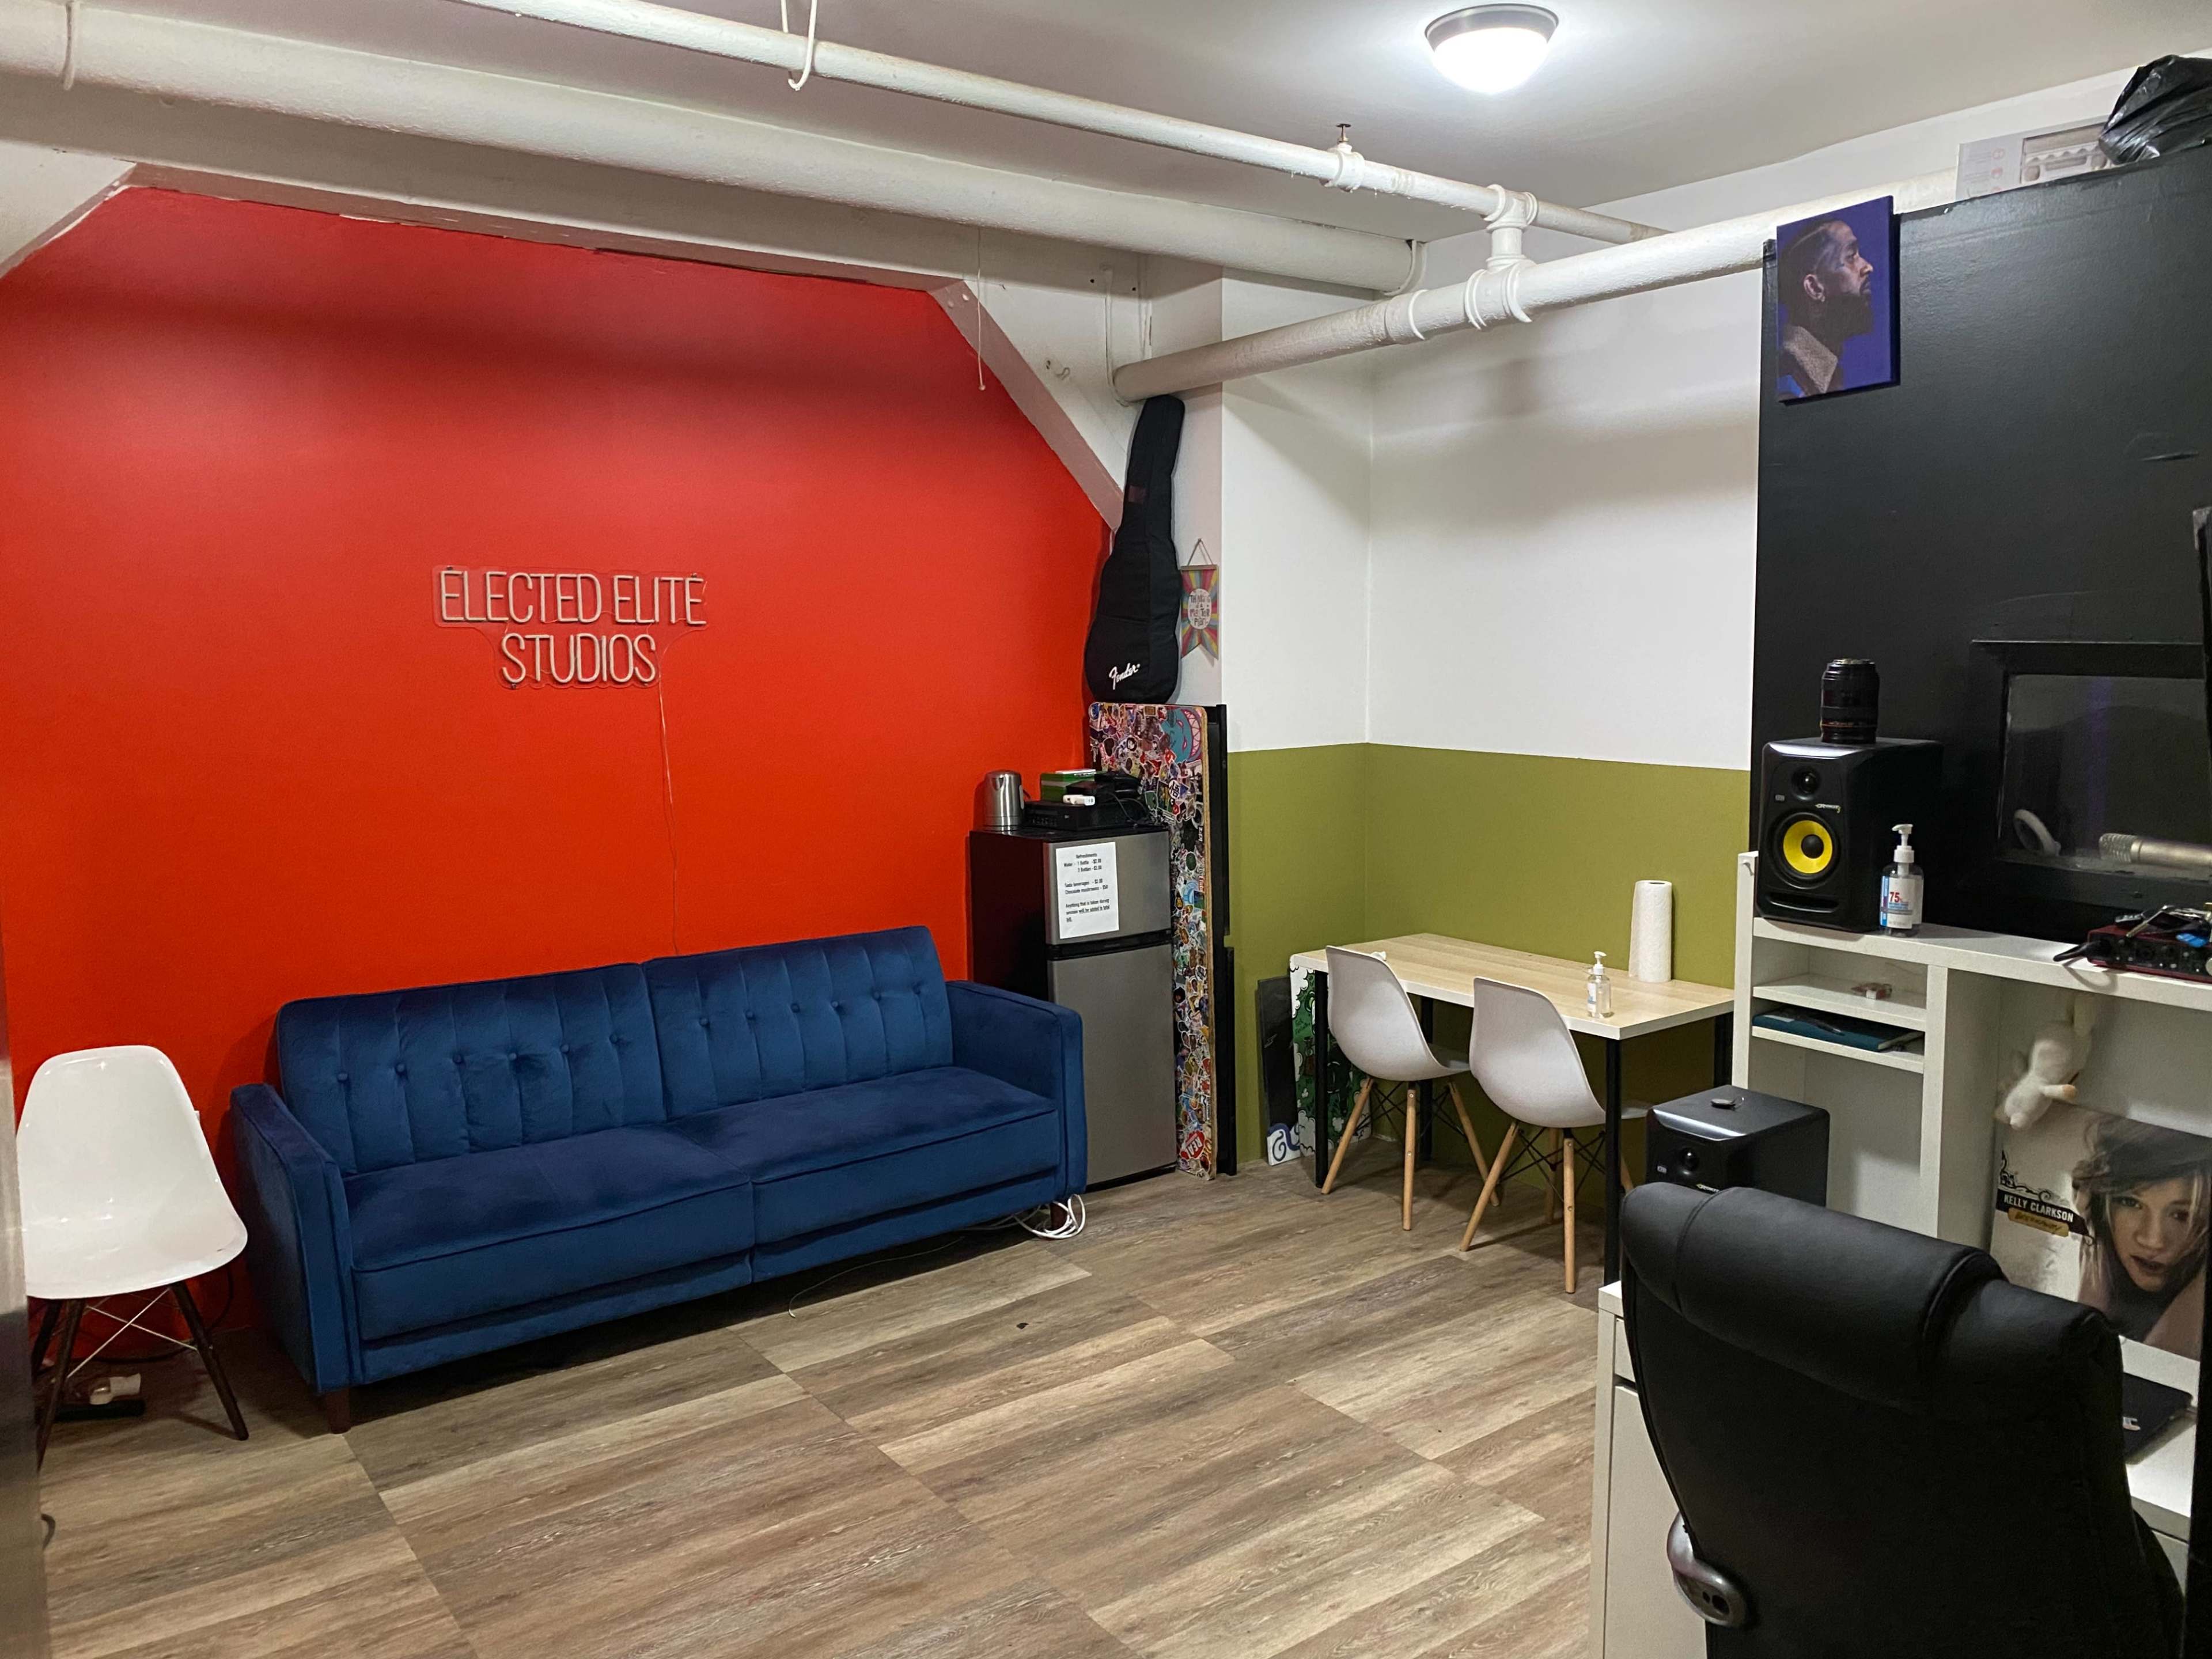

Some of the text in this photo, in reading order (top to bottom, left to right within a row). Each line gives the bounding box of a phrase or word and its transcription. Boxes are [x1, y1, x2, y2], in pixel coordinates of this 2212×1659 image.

[440, 570, 707, 626] ELECTED ELITE
[501, 632, 656, 683] STUDIOS
[1108, 662, 1140, 690] Fender
[2003, 1194, 2028, 1209] KELLY
[2030, 1202, 2074, 1222] CLARKSON
